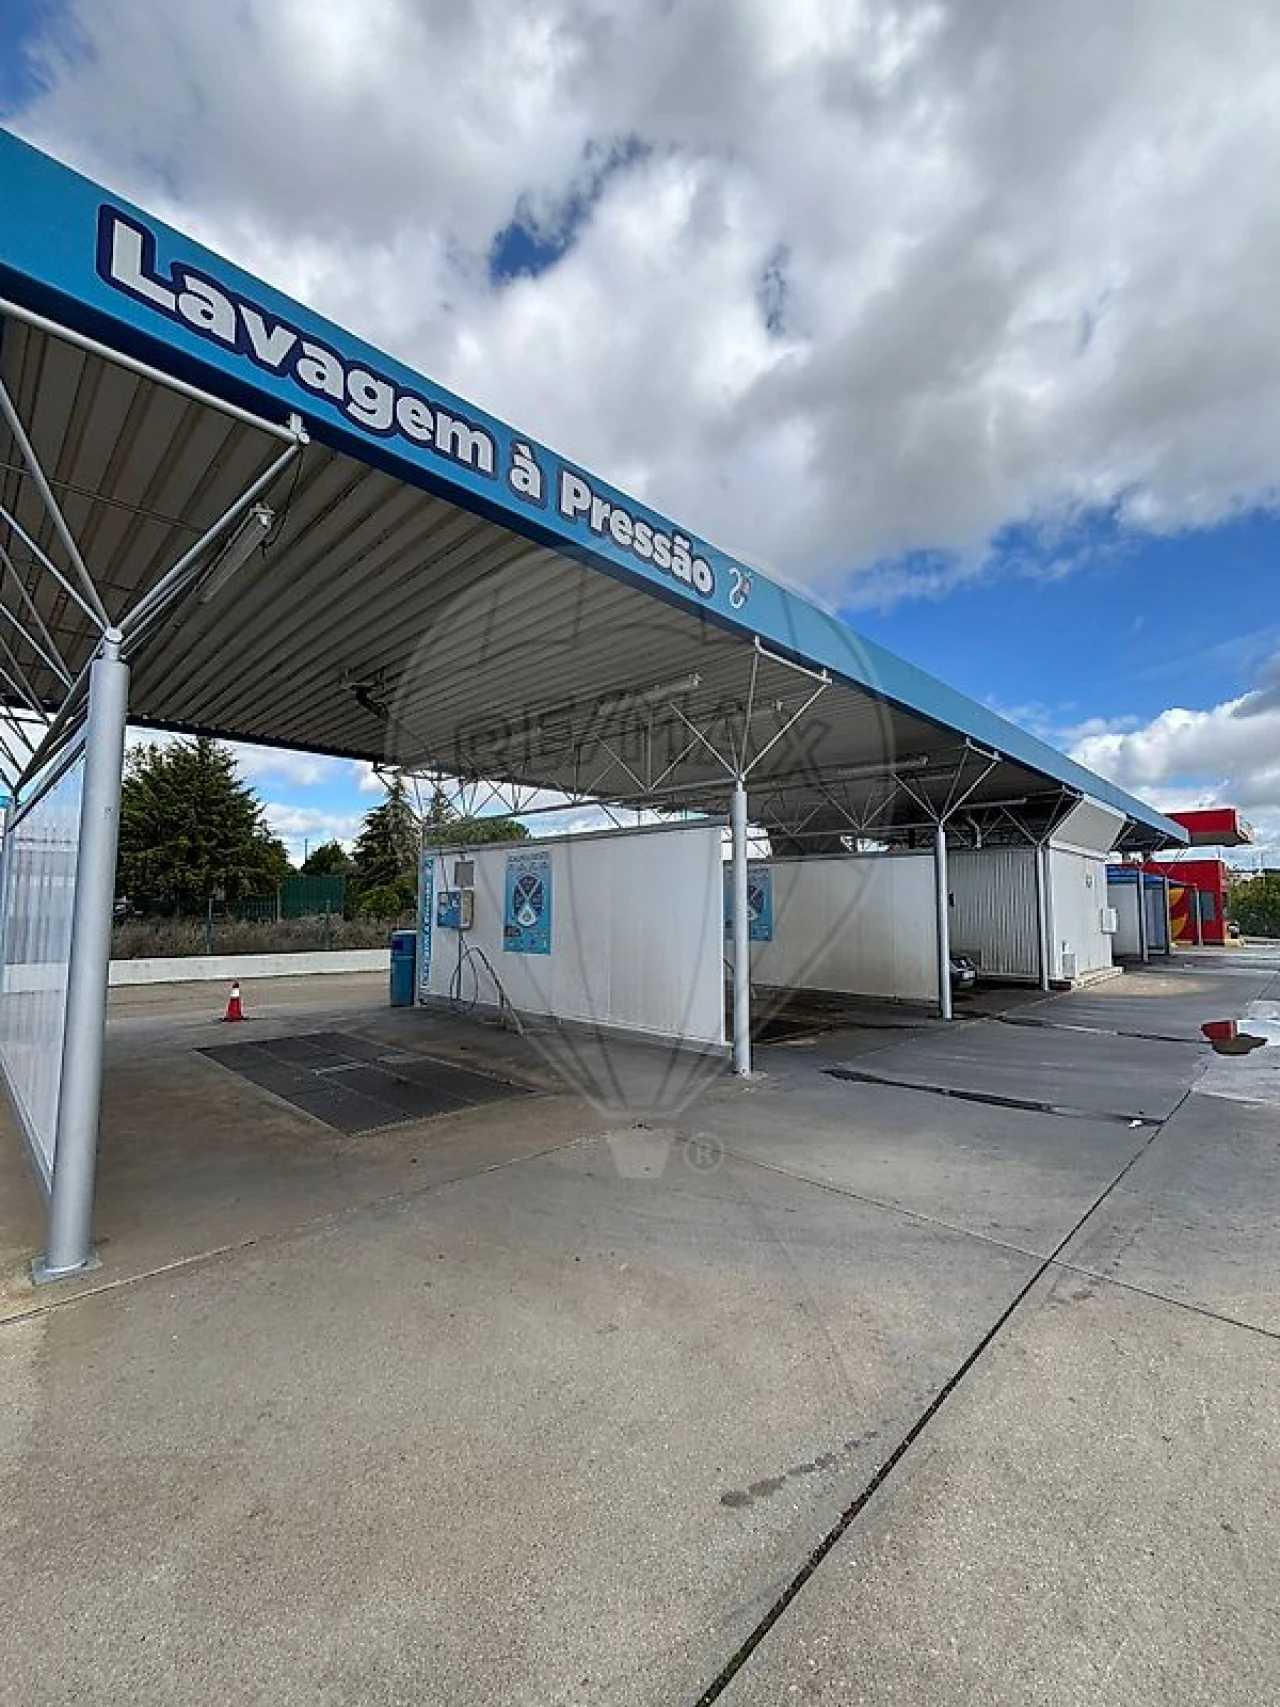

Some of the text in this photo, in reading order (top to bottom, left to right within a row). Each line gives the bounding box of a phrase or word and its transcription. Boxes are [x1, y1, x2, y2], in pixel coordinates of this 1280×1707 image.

[108, 216, 715, 594] Lavagem à Pressão
